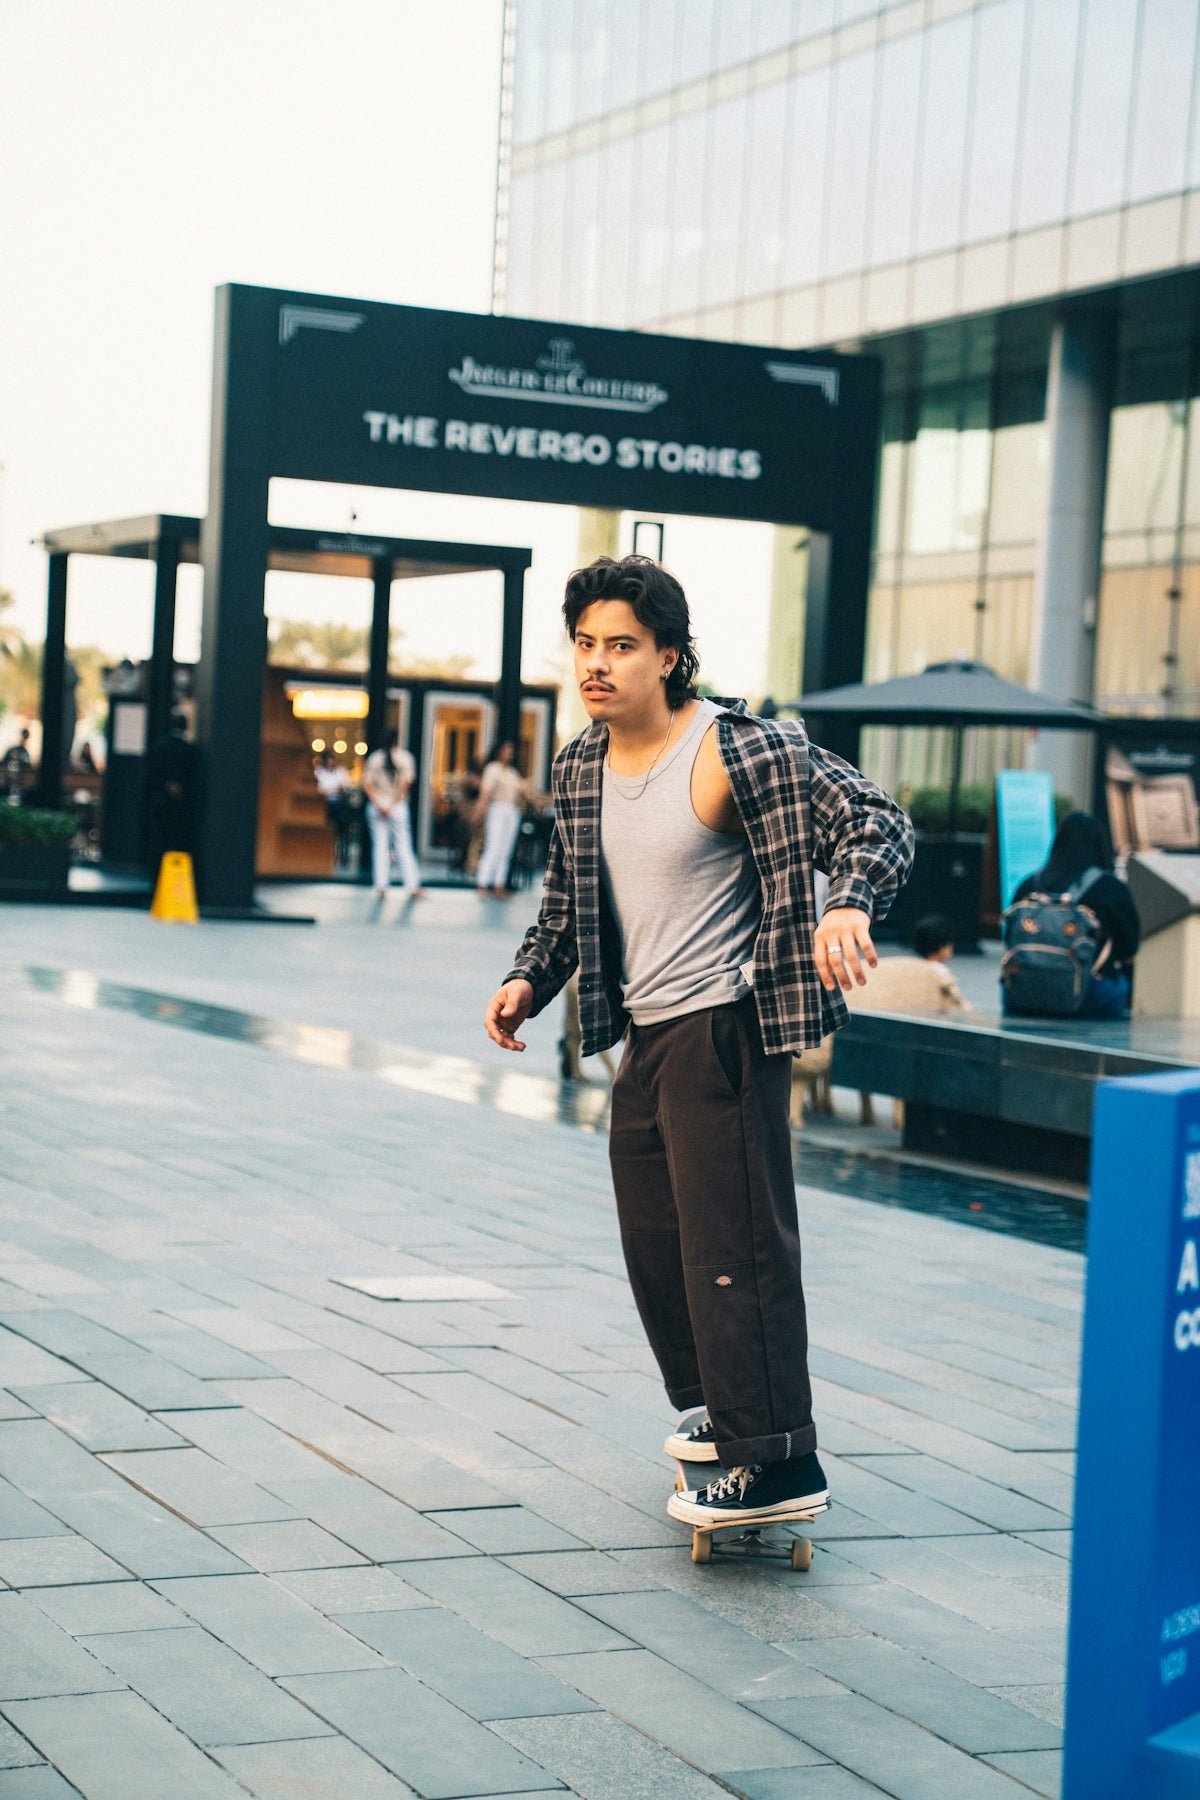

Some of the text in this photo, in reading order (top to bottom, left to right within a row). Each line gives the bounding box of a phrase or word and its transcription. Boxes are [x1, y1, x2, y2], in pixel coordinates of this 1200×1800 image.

[363, 410, 762, 480] THE REVERSO STORIES
